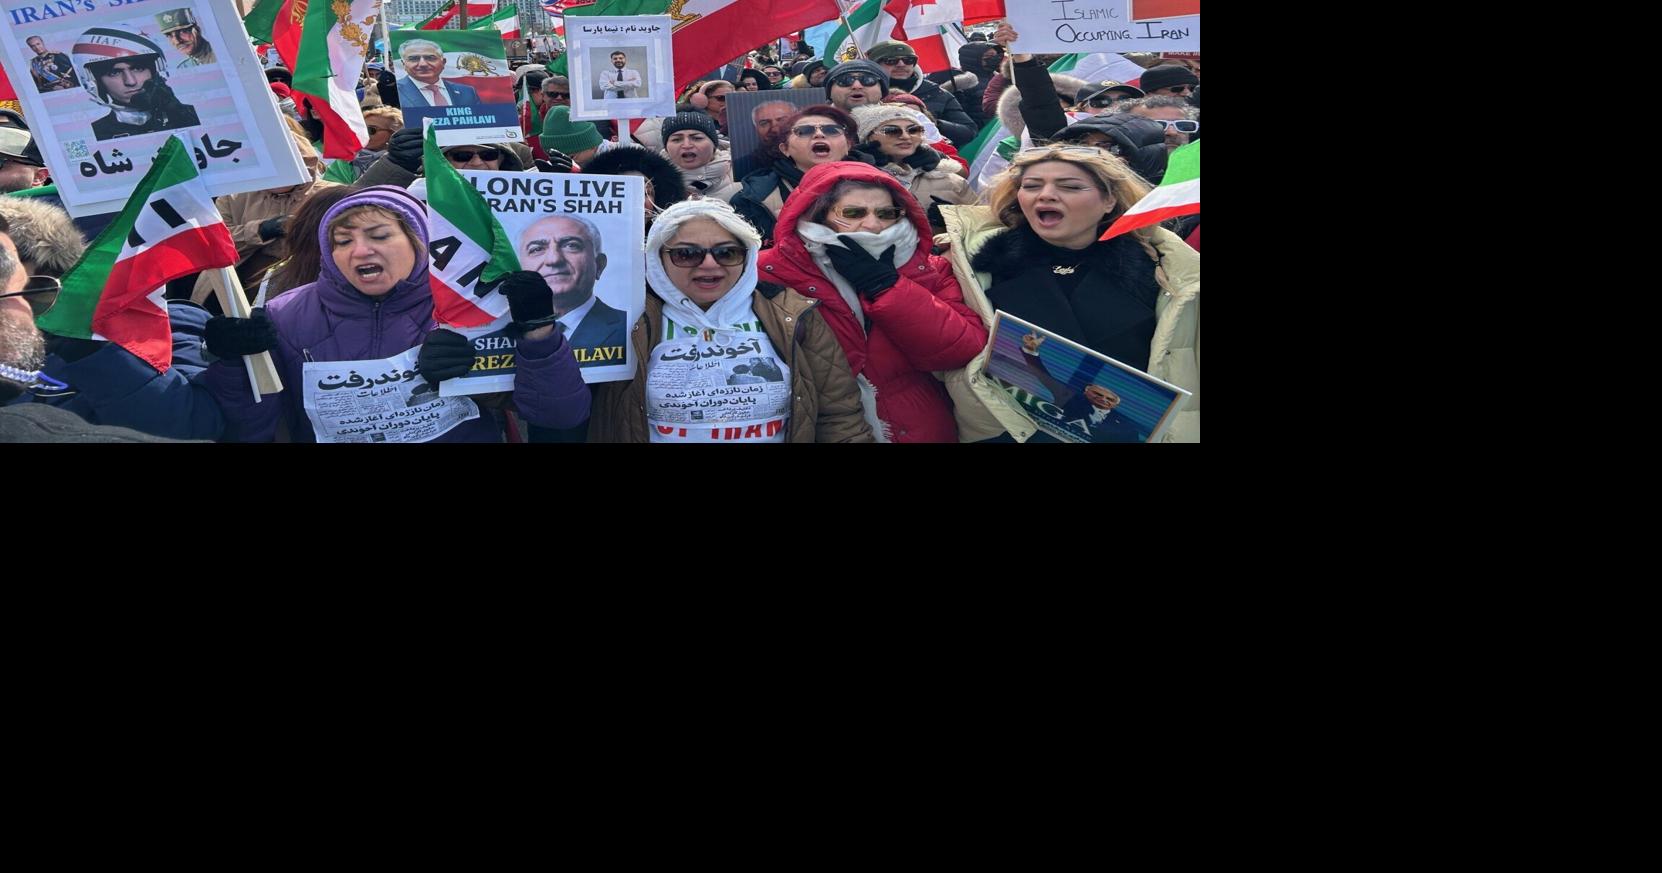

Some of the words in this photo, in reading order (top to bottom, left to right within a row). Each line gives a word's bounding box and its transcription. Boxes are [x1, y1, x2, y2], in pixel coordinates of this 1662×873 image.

[10, 0, 95, 25] IRAN's
[1051, 0, 1120, 20] ISLAMIC
[1055, 23, 1132, 43] OCCUPYING
[1135, 21, 1190, 40] IRAN
[432, 117, 451, 126] EZA
[452, 115, 496, 125] PAHLAVI
[445, 106, 472, 116] KING
[80, 148, 133, 177] شاه
[470, 176, 553, 197] LONG
[564, 179, 625, 198] LIVE
[487, 197, 557, 213] RAN'S
[563, 199, 622, 214] SHAH
[470, 353, 517, 371] REZ
